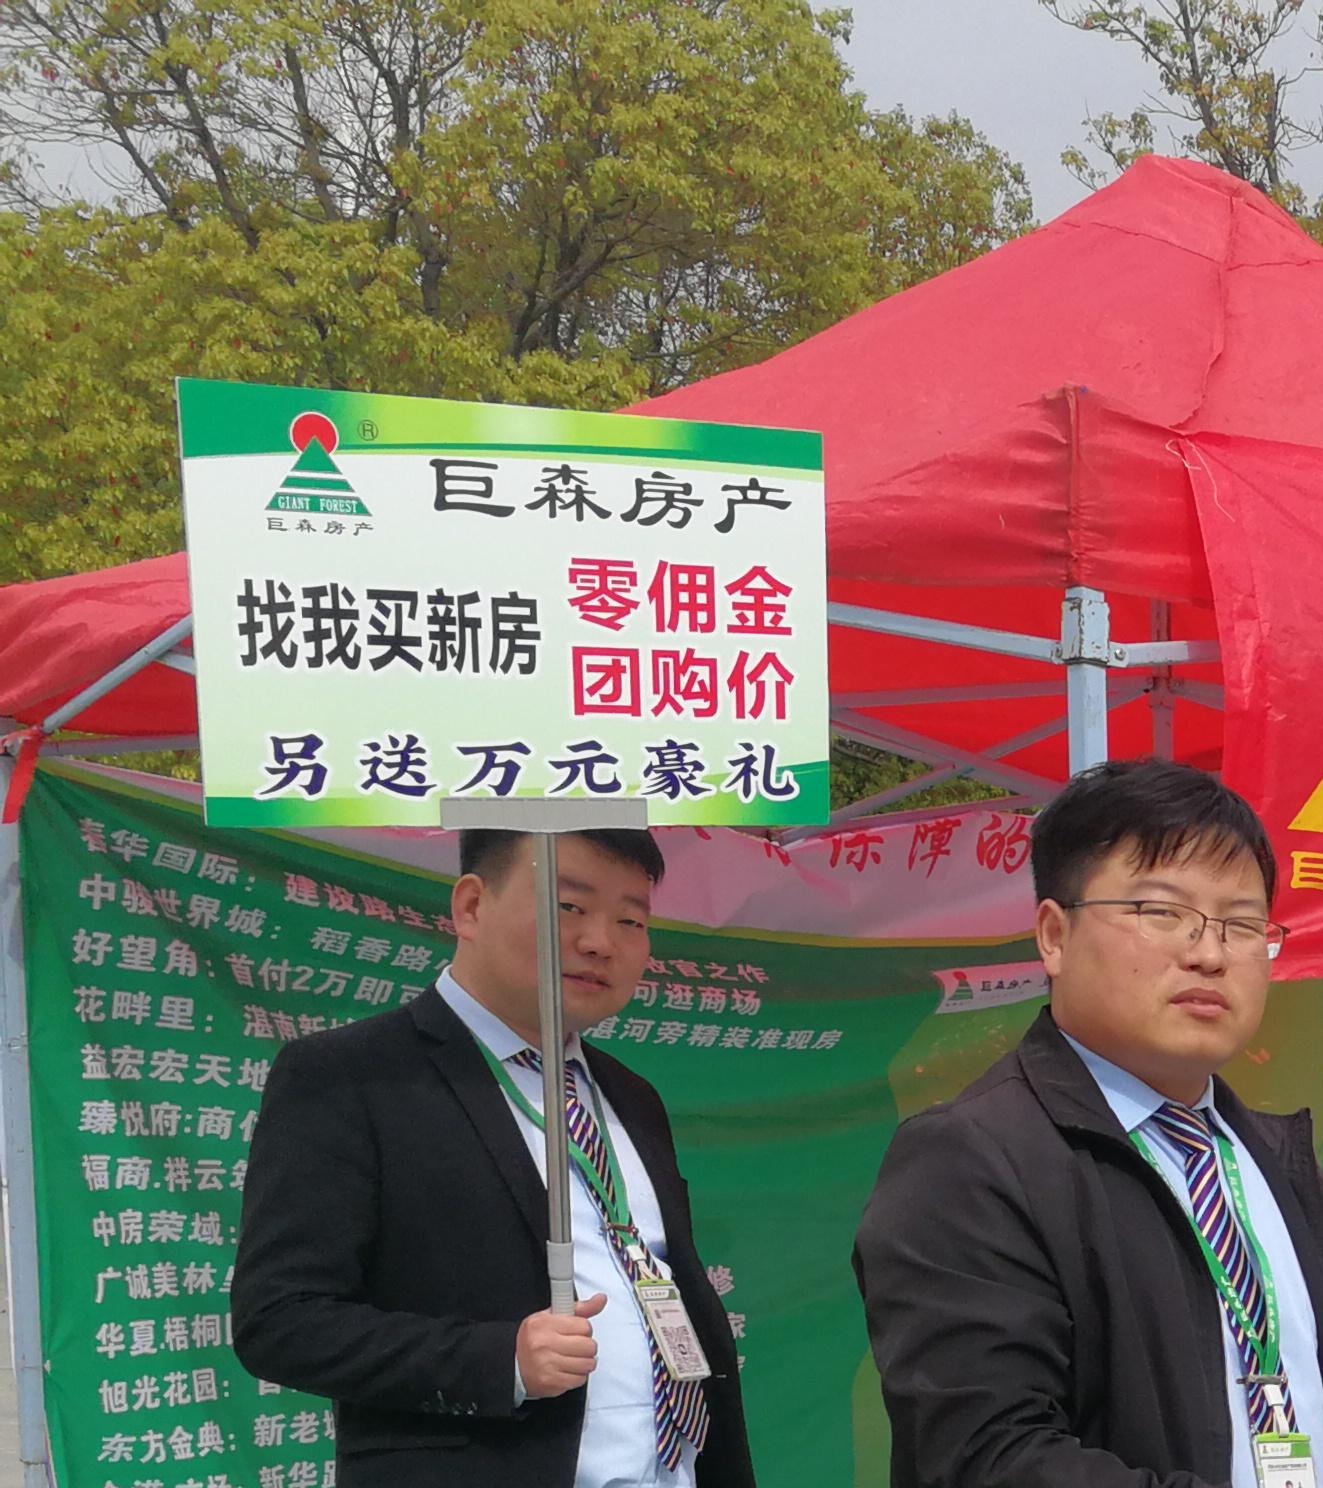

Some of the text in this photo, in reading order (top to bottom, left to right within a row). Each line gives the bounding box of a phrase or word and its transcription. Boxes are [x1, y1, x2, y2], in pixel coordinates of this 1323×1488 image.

[266, 517, 374, 537] 巨森房产
[277, 495, 360, 515] GIANT FOREST
[430, 459, 792, 534] 巨森房产
[237, 578, 542, 676] 找我买新房
[567, 557, 793, 636] 零佣金
[571, 646, 794, 721] 团购价
[259, 733, 800, 800] 另送万元豪礼
